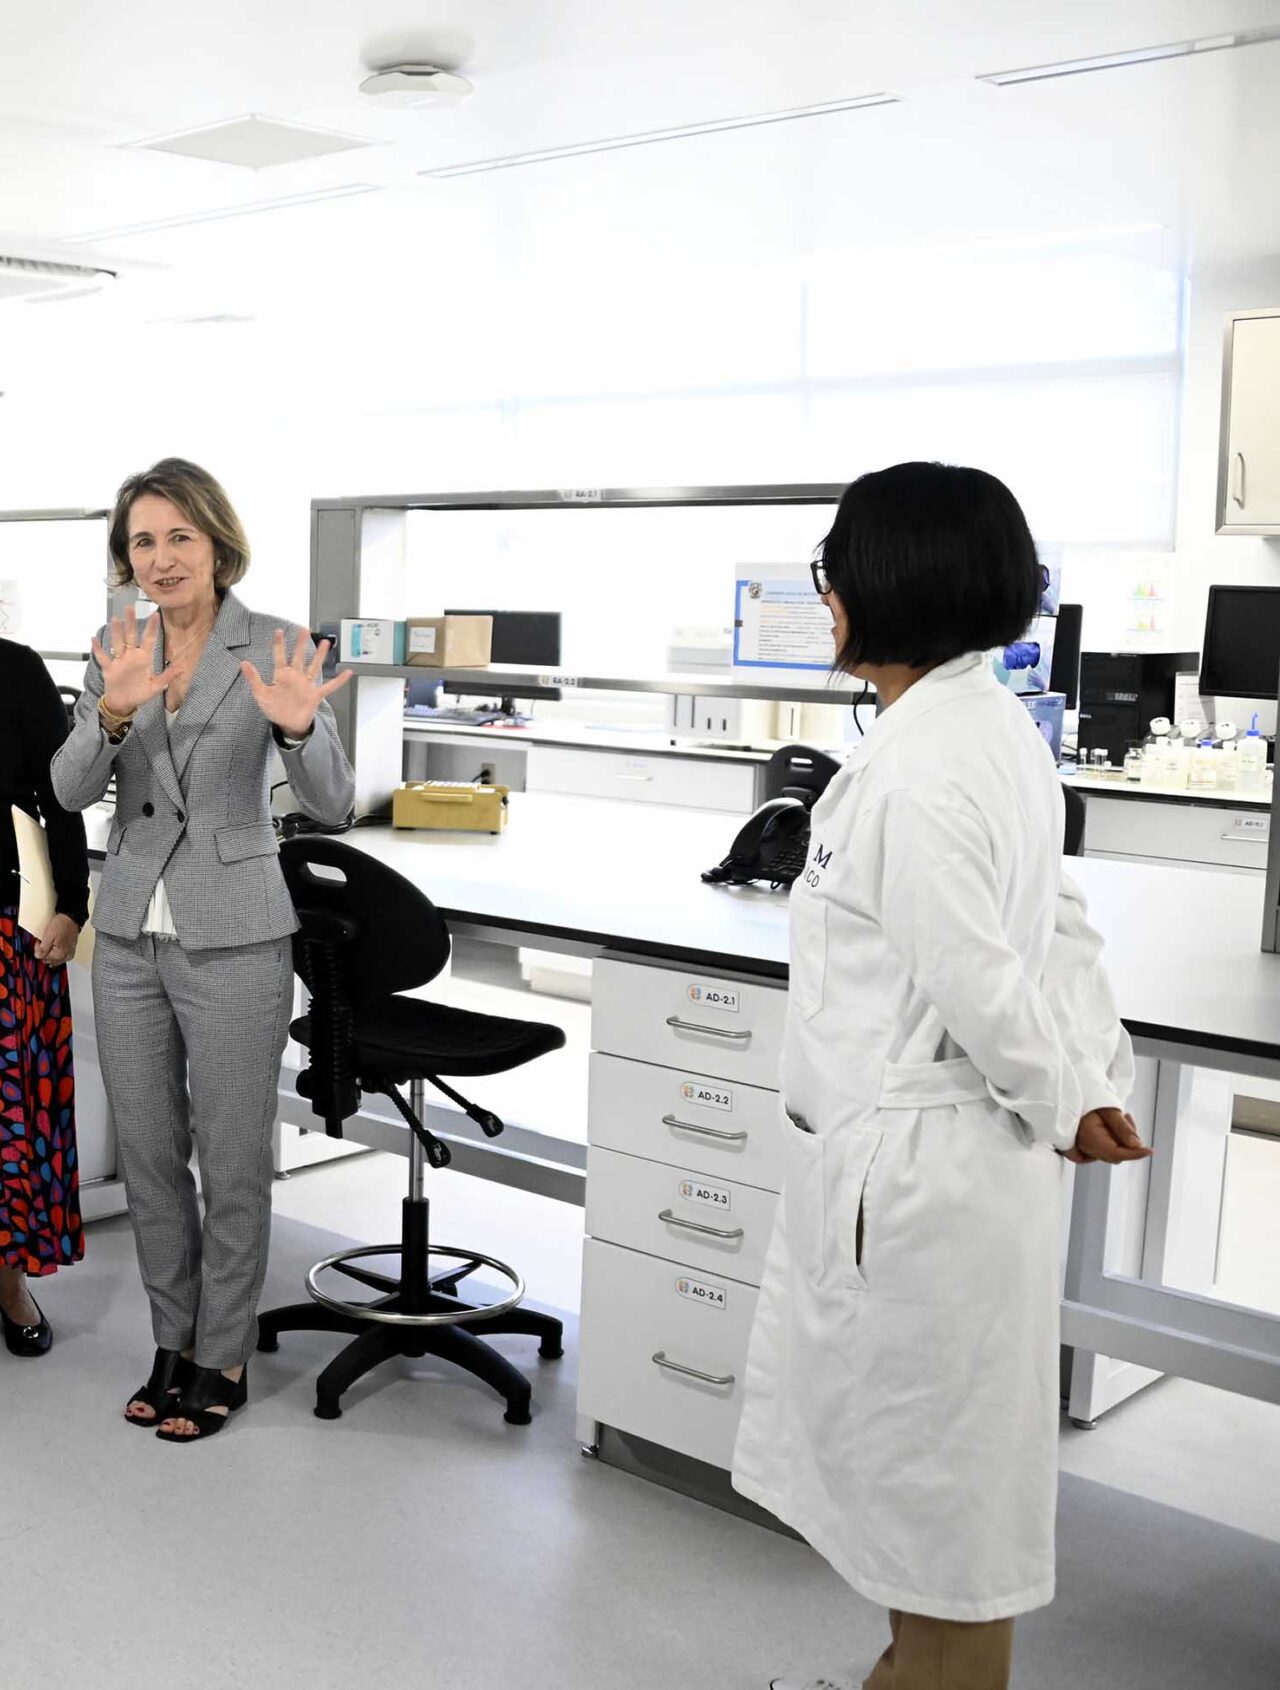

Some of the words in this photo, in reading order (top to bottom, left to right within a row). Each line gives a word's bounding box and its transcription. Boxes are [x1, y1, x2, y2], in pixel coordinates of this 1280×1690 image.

[705, 992, 736, 1006] AD-2.1
[697, 1090, 730, 1105] AD-2.2
[696, 1189, 728, 1204] AD-2.3
[692, 1286, 724, 1302] AD-2.4
